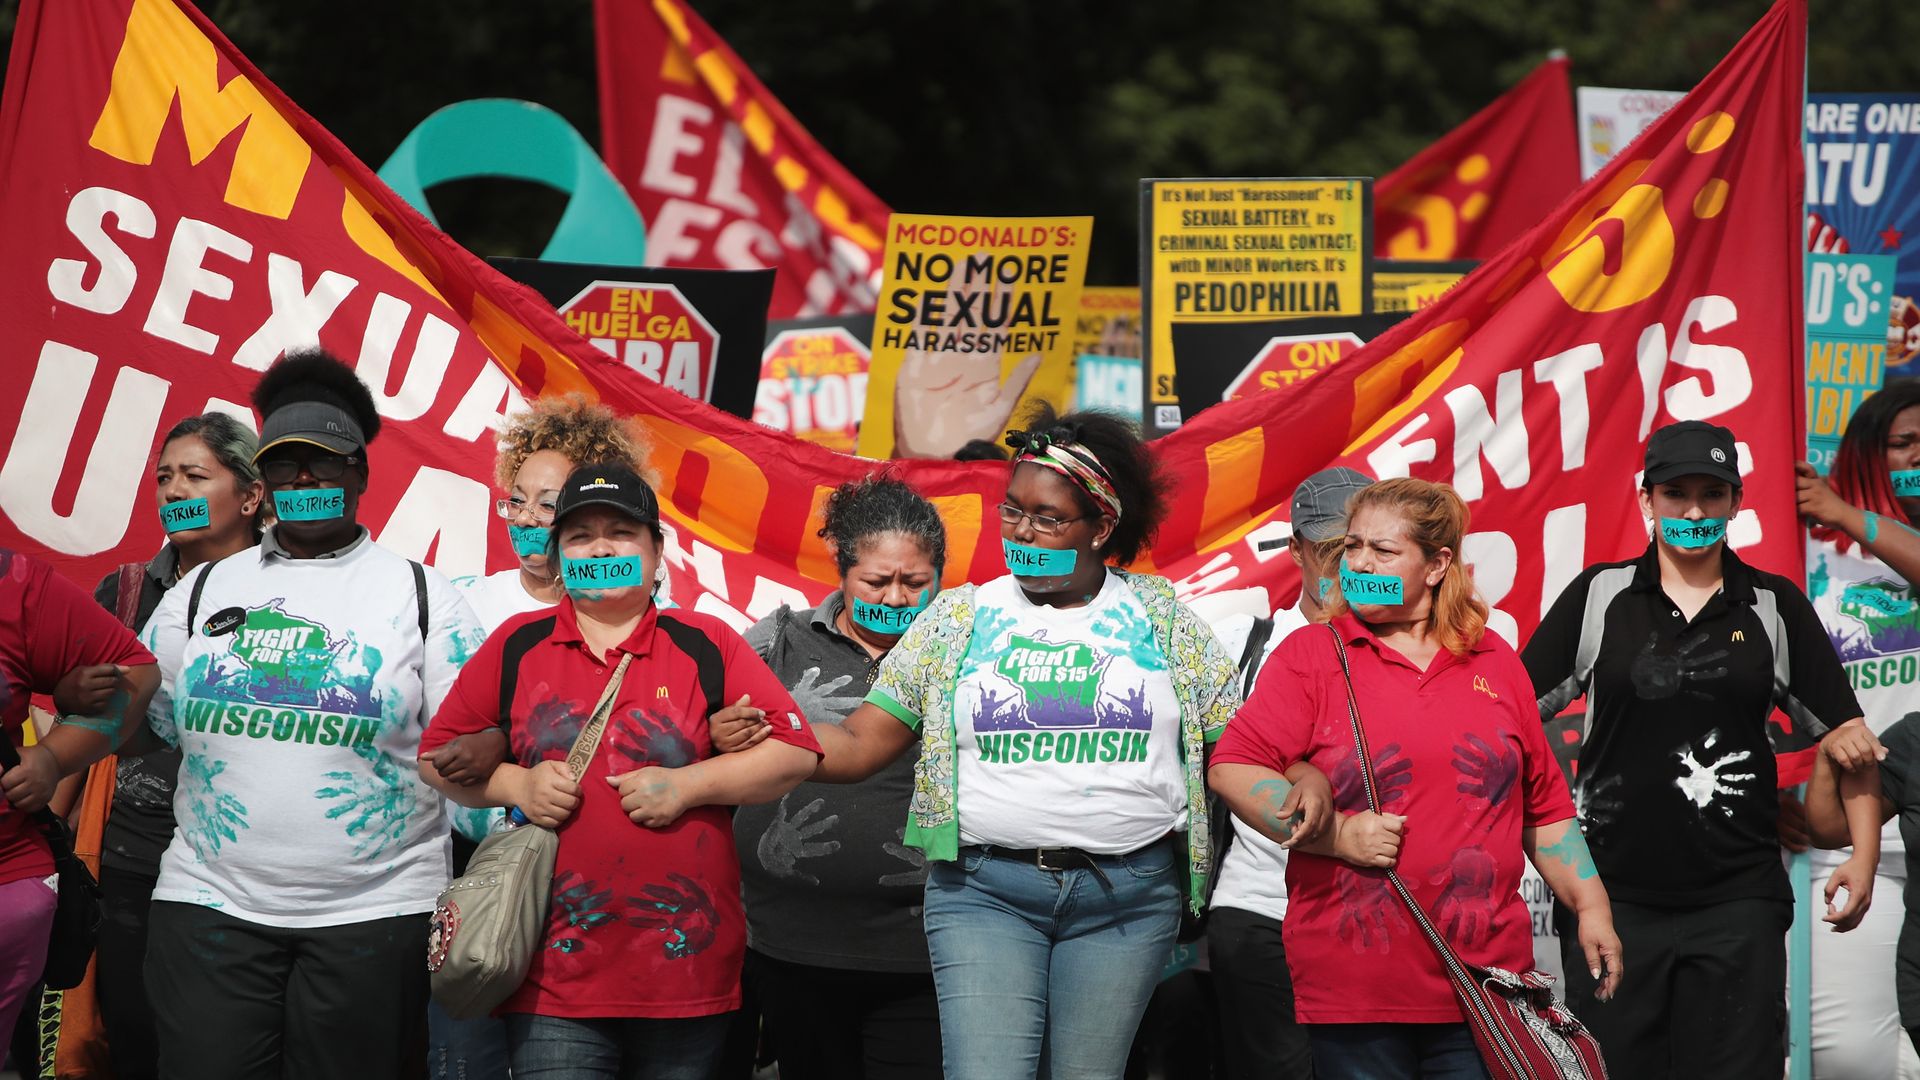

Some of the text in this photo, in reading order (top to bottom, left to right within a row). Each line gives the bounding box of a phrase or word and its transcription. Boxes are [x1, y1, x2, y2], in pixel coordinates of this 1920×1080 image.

[1185, 188, 1205, 202] Not
[1209, 188, 1234, 202] Just
[1182, 209, 1238, 226] SEXUAL
[895, 223, 1076, 247] MCDONALD'S:
[1159, 235, 1228, 250] CRIMINAL
[1233, 234, 1284, 250] SEXUAL
[895, 252, 1069, 284] NO MORE
[1170, 257, 1201, 273] with
[1205, 257, 1252, 273] MINOR
[610, 288, 653, 313] EN
[888, 288, 1060, 328] SEXUAL
[1174, 281, 1341, 312] PEDOPHILIA
[565, 311, 692, 339] HUELGA
[794, 336, 834, 355] ON
[883, 328, 1060, 353] HARASSMENT
[770, 352, 860, 380] STRIKE
[1289, 340, 1341, 368] ON
[1636, 295, 1752, 442] IS
[167, 503, 206, 523] STRIKE
[297, 495, 342, 513] STRIKE
[241, 627, 314, 650] FIGHT
[248, 648, 283, 665] FOR
[1005, 644, 1080, 669] FIGHT
[1018, 665, 1088, 684] FOR $15
[184, 700, 382, 749] WISCONSIN
[975, 731, 1151, 765] WISCONSIN
